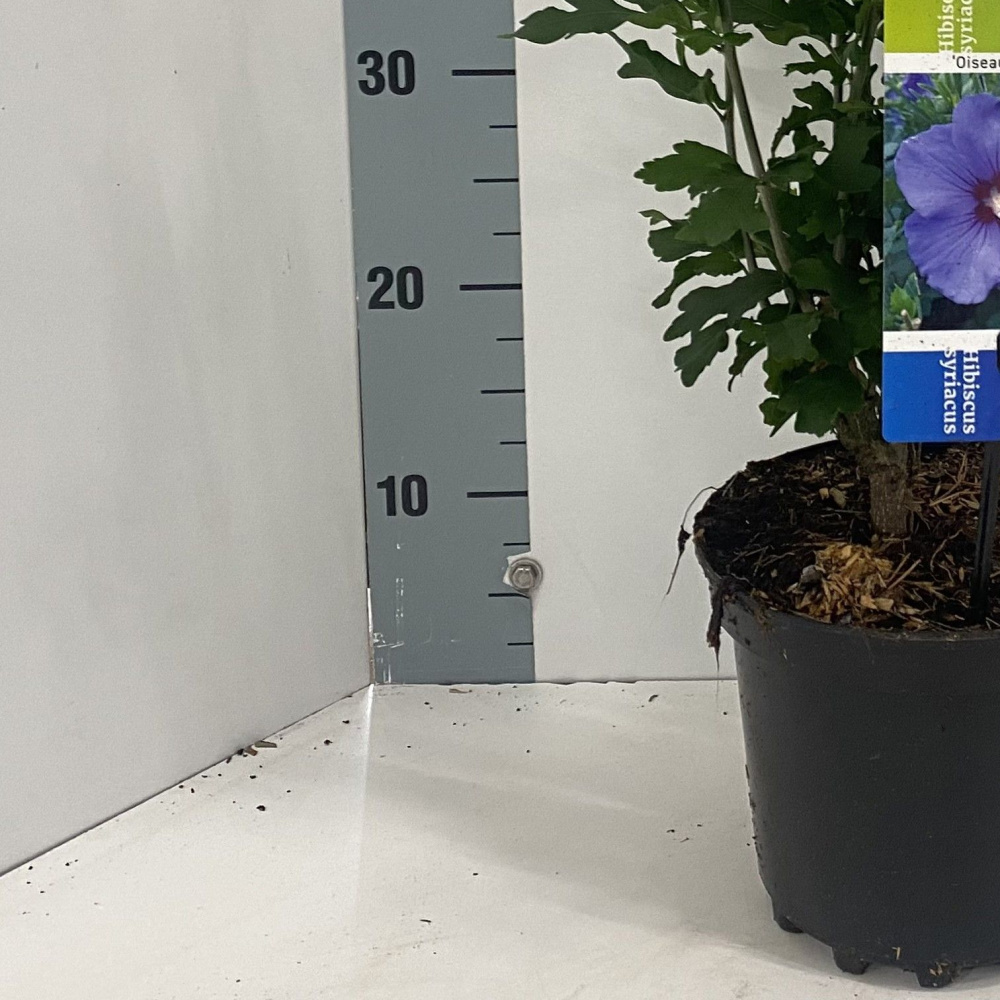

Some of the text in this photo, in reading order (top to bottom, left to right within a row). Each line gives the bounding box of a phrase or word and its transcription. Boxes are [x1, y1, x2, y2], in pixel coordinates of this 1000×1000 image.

[357, 49, 416, 96] 30
[366, 265, 424, 310] 20
[939, 349, 961, 435] syriacus
[963, 349, 981, 435] Hibiscus
[376, 474, 429, 517] 10
